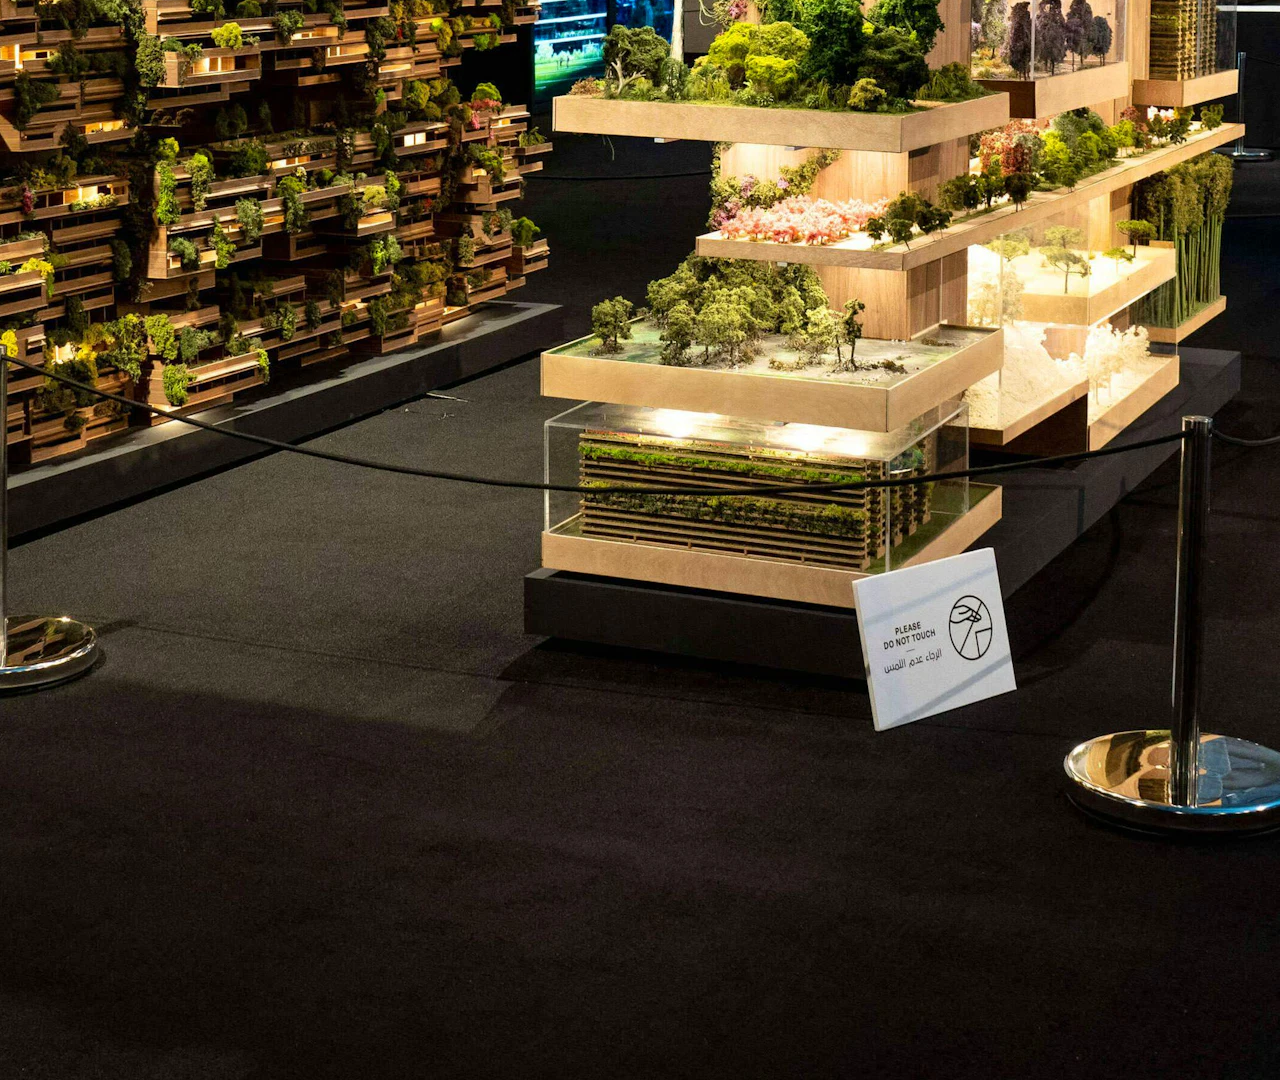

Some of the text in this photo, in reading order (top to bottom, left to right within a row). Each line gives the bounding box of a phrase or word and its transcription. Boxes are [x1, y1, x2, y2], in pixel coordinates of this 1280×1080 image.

[895, 621, 922, 635] PLEASE
[883, 629, 936, 650] DO NOT TOUCH
[884, 648, 943, 674] الرجاء عدم اللمس
